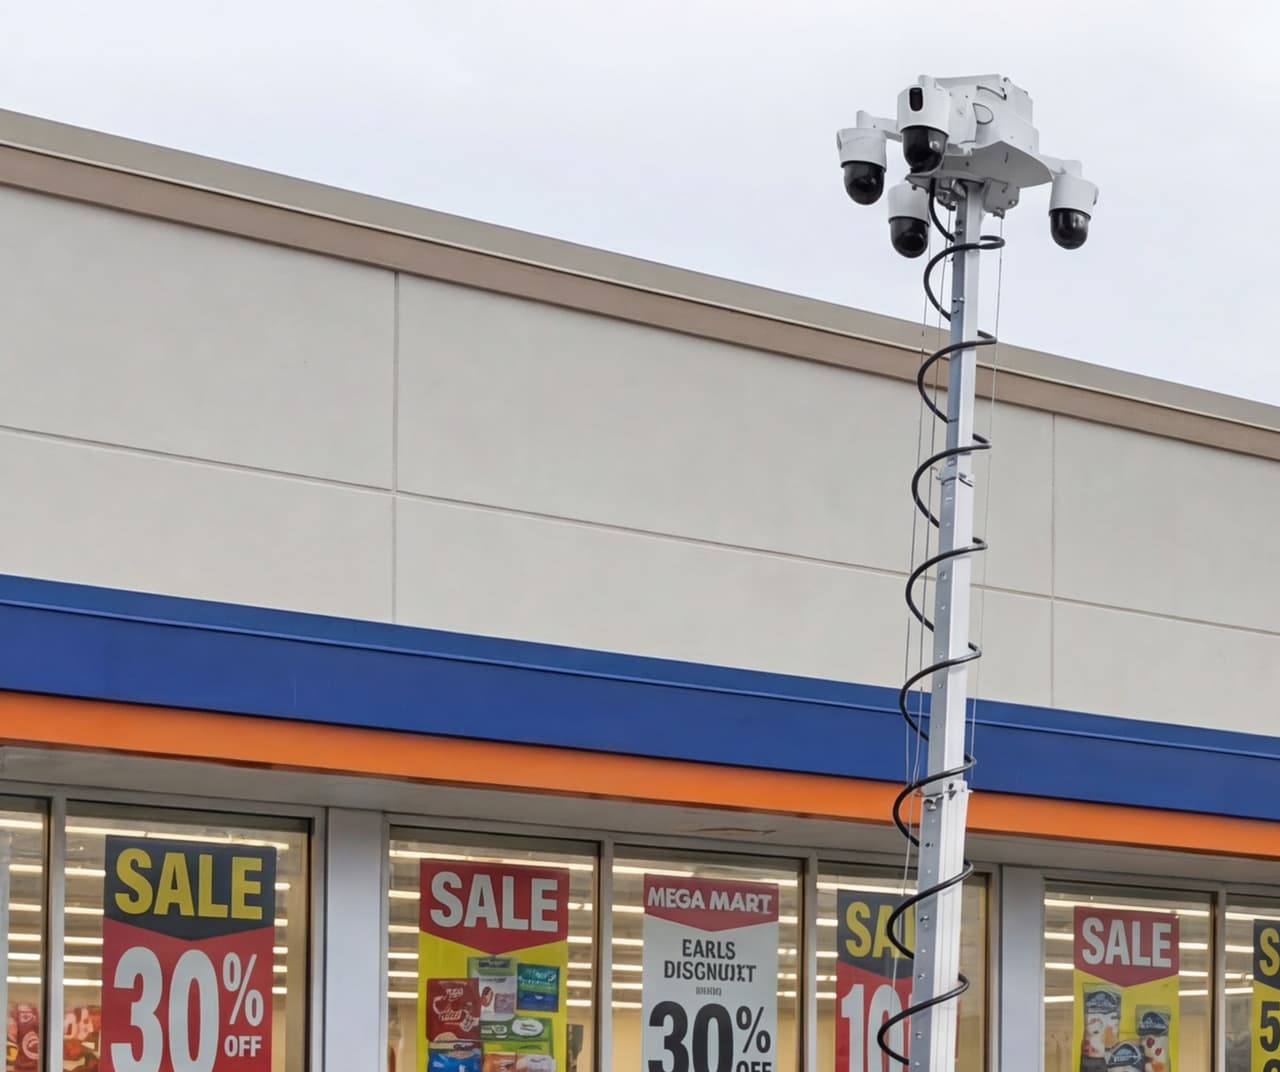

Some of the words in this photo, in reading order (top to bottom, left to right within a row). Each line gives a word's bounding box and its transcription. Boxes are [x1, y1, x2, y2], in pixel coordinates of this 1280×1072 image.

[114, 848, 263, 920] SALE
[430, 871, 558, 932] SALE
[648, 886, 705, 910] MEGA
[709, 890, 773, 915] MART
[682, 938, 737, 960] EARLS
[1082, 917, 1172, 968] SALE
[224, 1035, 263, 1057] OFF
